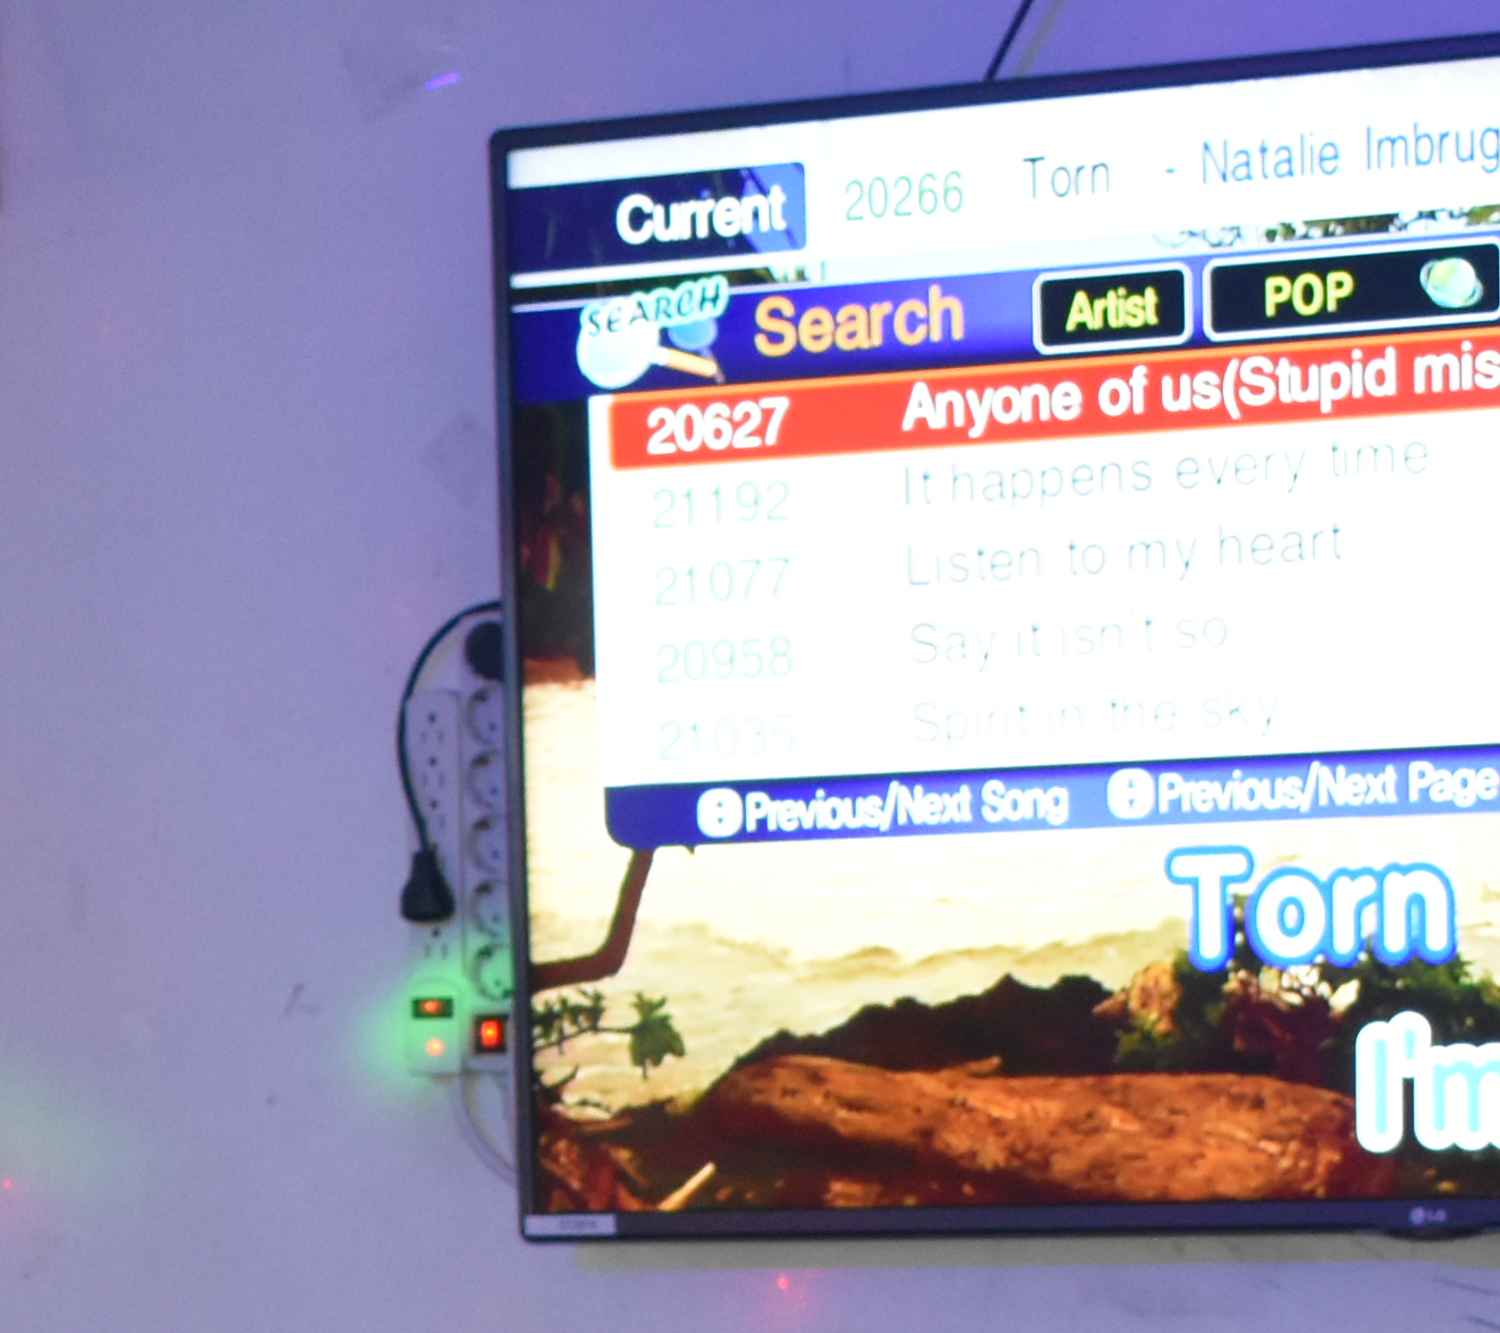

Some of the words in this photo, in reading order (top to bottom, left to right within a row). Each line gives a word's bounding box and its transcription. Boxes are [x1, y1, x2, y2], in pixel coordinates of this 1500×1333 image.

[616, 184, 787, 247] Current
[843, 169, 965, 222] 20266
[1023, 155, 1112, 199] Torn
[1201, 132, 1341, 186] Natalie
[586, 281, 723, 338] SEARCH
[753, 285, 965, 358] Search
[1064, 287, 1158, 333] Artist
[1263, 273, 1354, 318] POP
[647, 397, 789, 456] 20627
[902, 381, 1082, 438] Anyone
[1098, 364, 1148, 416] of
[1162, 347, 1397, 420] us(Stupid
[652, 481, 791, 529] 21192
[902, 465, 933, 507] It
[948, 455, 1152, 512] happens
[1176, 447, 1307, 495] every
[1330, 436, 1430, 477] time
[655, 557, 791, 606] 21077
[907, 541, 1053, 588] Listen
[1068, 537, 1106, 576] to
[1128, 534, 1199, 582] my
[1218, 521, 1344, 569] heart
[656, 635, 794, 685] 20958
[911, 621, 998, 673] Say
[1014, 618, 1043, 661] it
[1061, 611, 1155, 658] isn't
[1175, 614, 1229, 652] so
[912, 701, 1025, 750] Spirit
[1048, 701, 1087, 739] in
[1106, 693, 1178, 735] the
[1201, 690, 1281, 741] sky
[744, 783, 974, 835] Previous/Next
[981, 780, 1070, 826] Song
[1157, 762, 1398, 819] Previous/Next
[1407, 759, 1500, 807] Page
[1166, 845, 1458, 972] Torn
